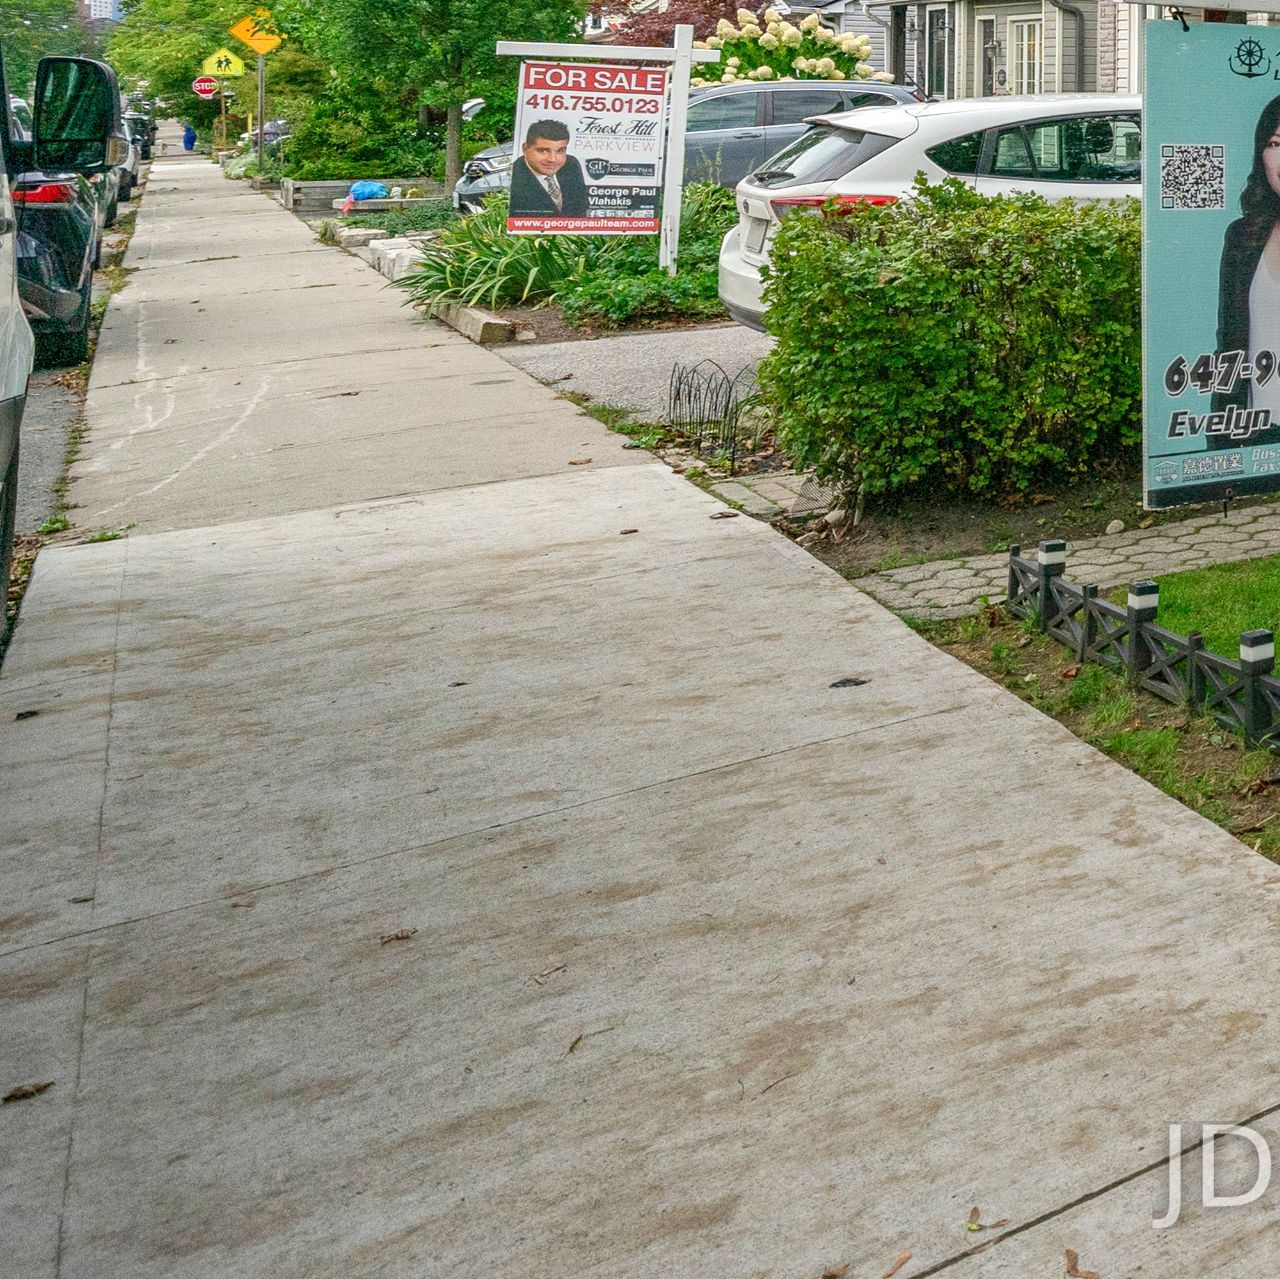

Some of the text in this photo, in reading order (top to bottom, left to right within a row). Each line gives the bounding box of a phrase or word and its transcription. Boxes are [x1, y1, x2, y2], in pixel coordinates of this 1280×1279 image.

[528, 67, 663, 92] FOR SALE
[526, 93, 659, 114] 416.755.0123
[576, 116, 658, 136] Forest Hill
[574, 140, 655, 152] PARKVIEW
[588, 160, 606, 170] GP
[588, 186, 657, 198] George Paul
[588, 197, 632, 206] Vlahakis
[514, 218, 655, 230] www.georgepaulteam.com
[1167, 404, 1272, 439] Evelyn
[1252, 448, 1280, 461] Bus:
[1252, 461, 1280, 474] Fax:
